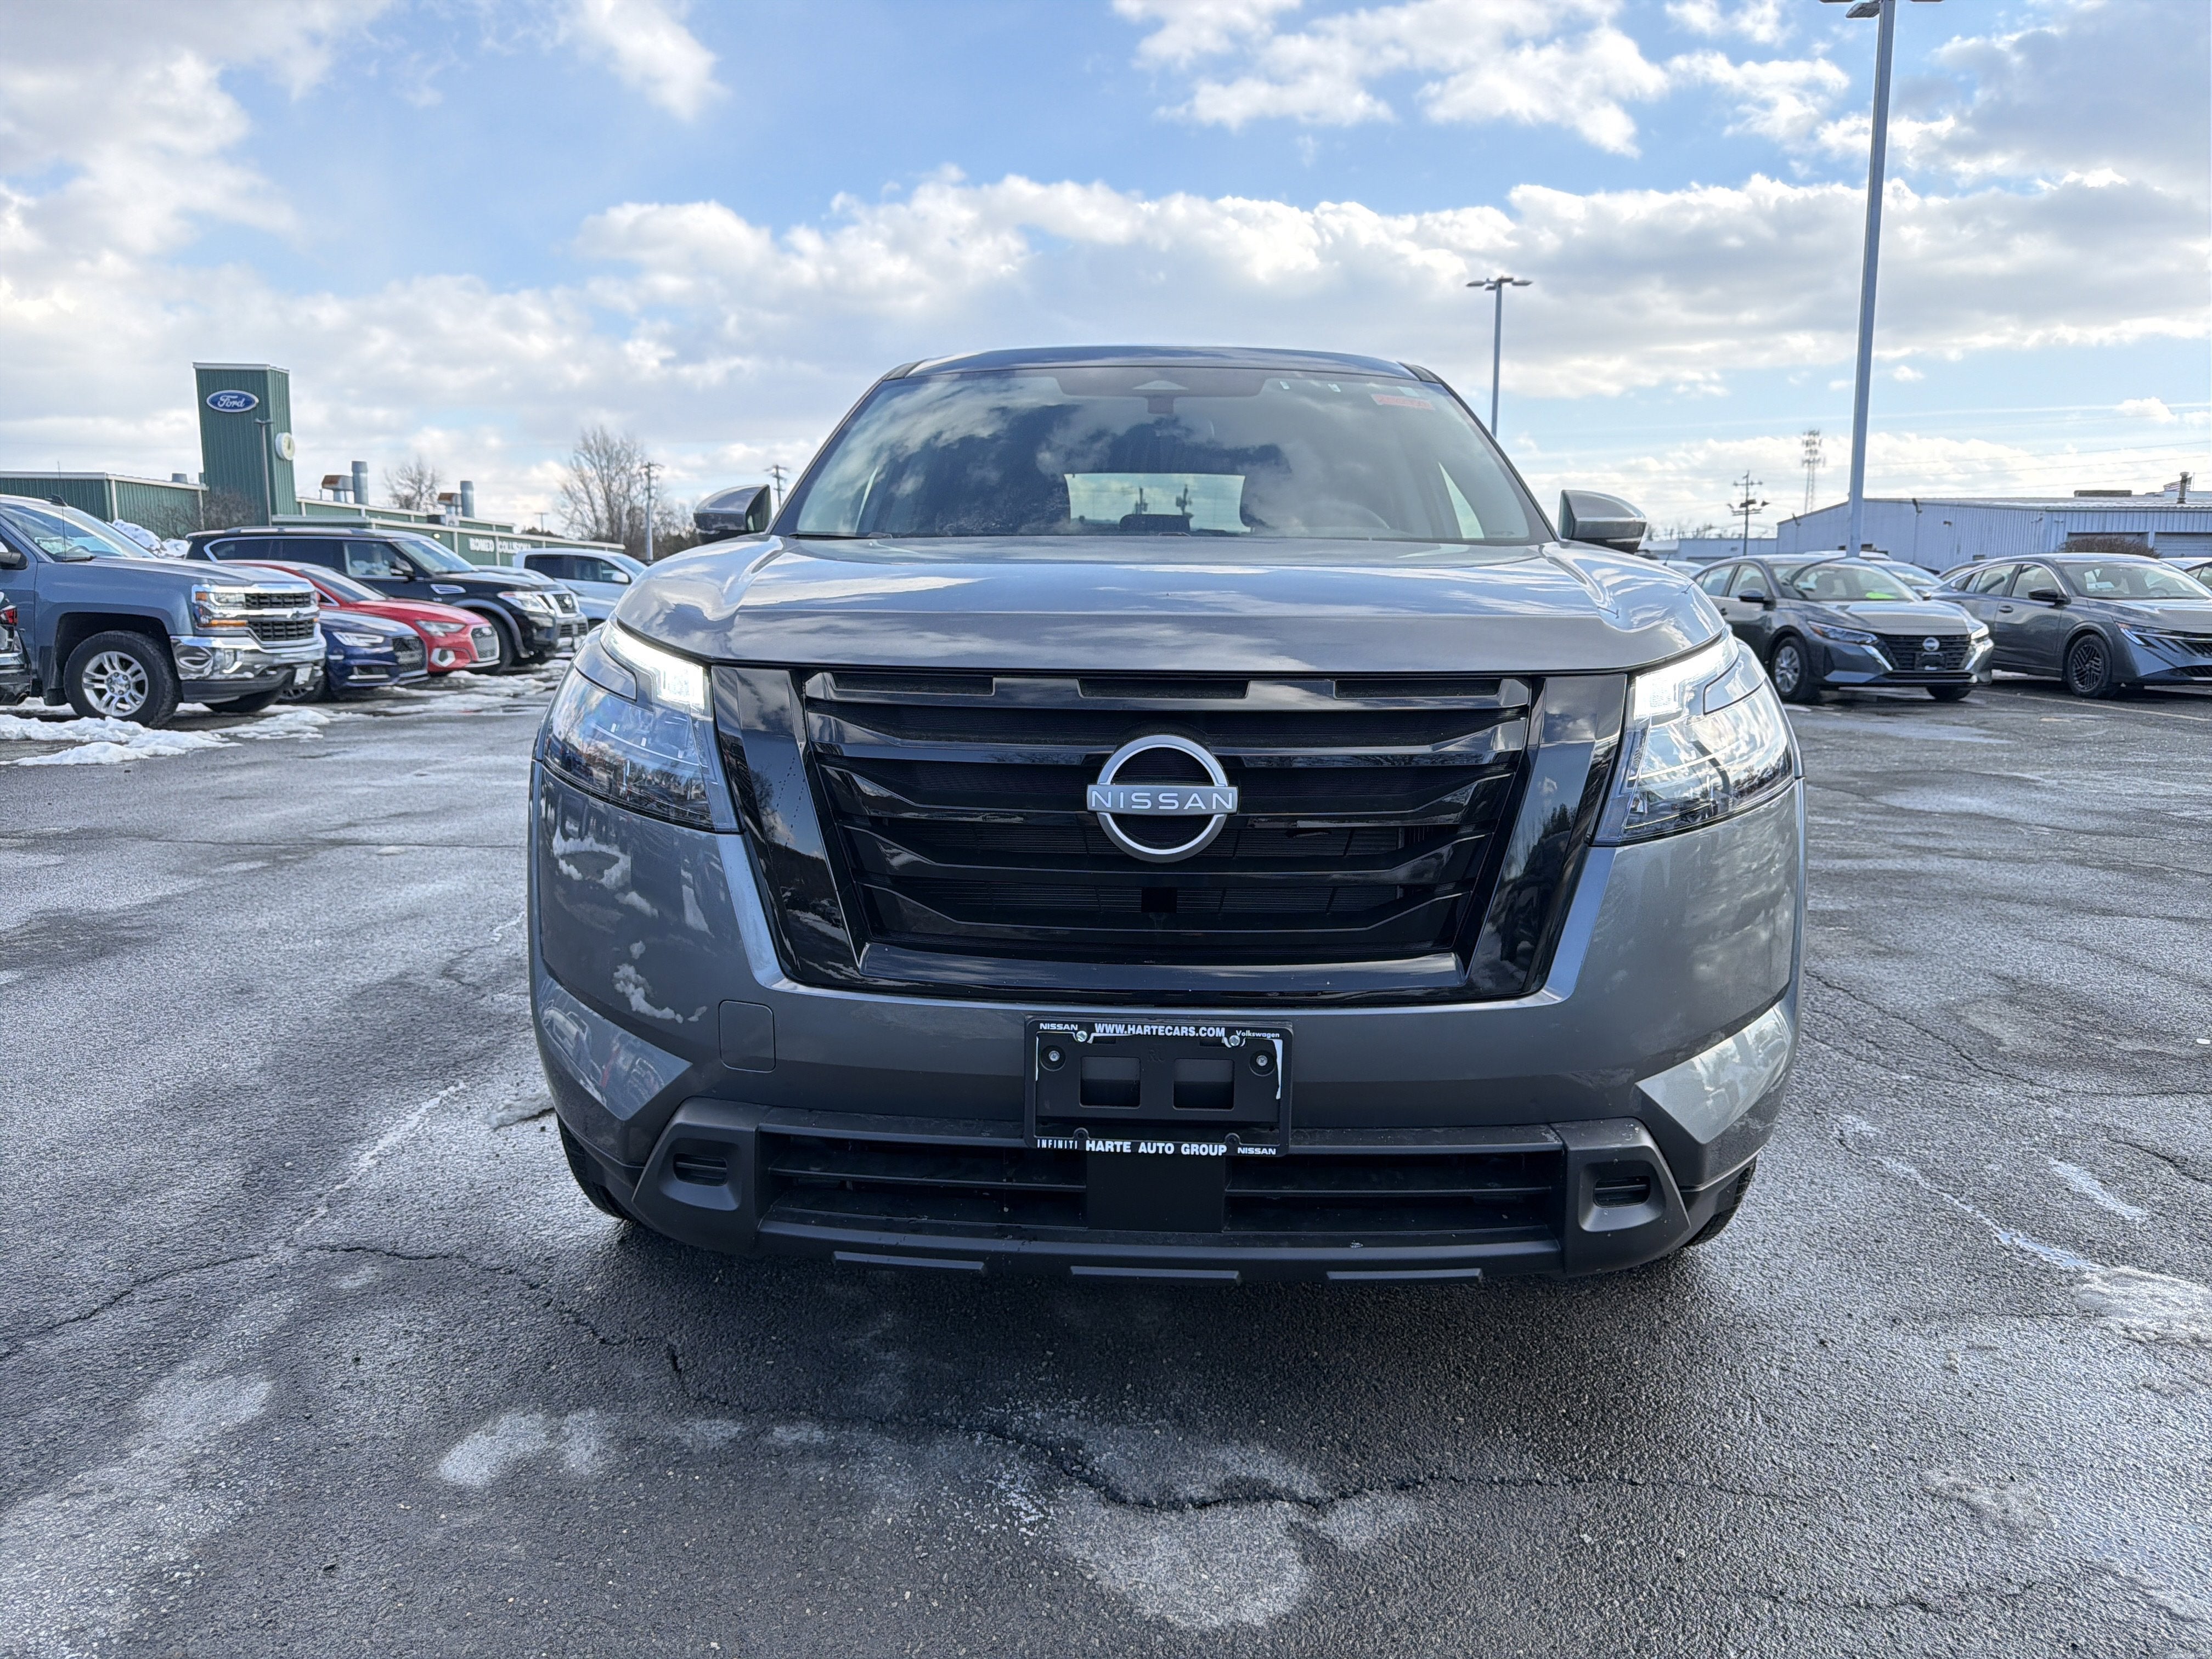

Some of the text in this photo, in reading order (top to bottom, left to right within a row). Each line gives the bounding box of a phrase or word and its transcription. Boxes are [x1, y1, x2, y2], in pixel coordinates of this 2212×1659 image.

[217, 395, 245, 407] Ford
[1091, 791, 1233, 810] NISSAN
[1040, 1023, 1078, 1031] NISSAN
[1094, 1023, 1225, 1037] WWW.HARTECARS.COM
[1235, 1030, 1280, 1039] Volkswagen
[1037, 1139, 1077, 1150] INFINITI
[1086, 1139, 1227, 1156] HARTE AUTO GROUP
[1237, 1147, 1277, 1155] NISSAN
